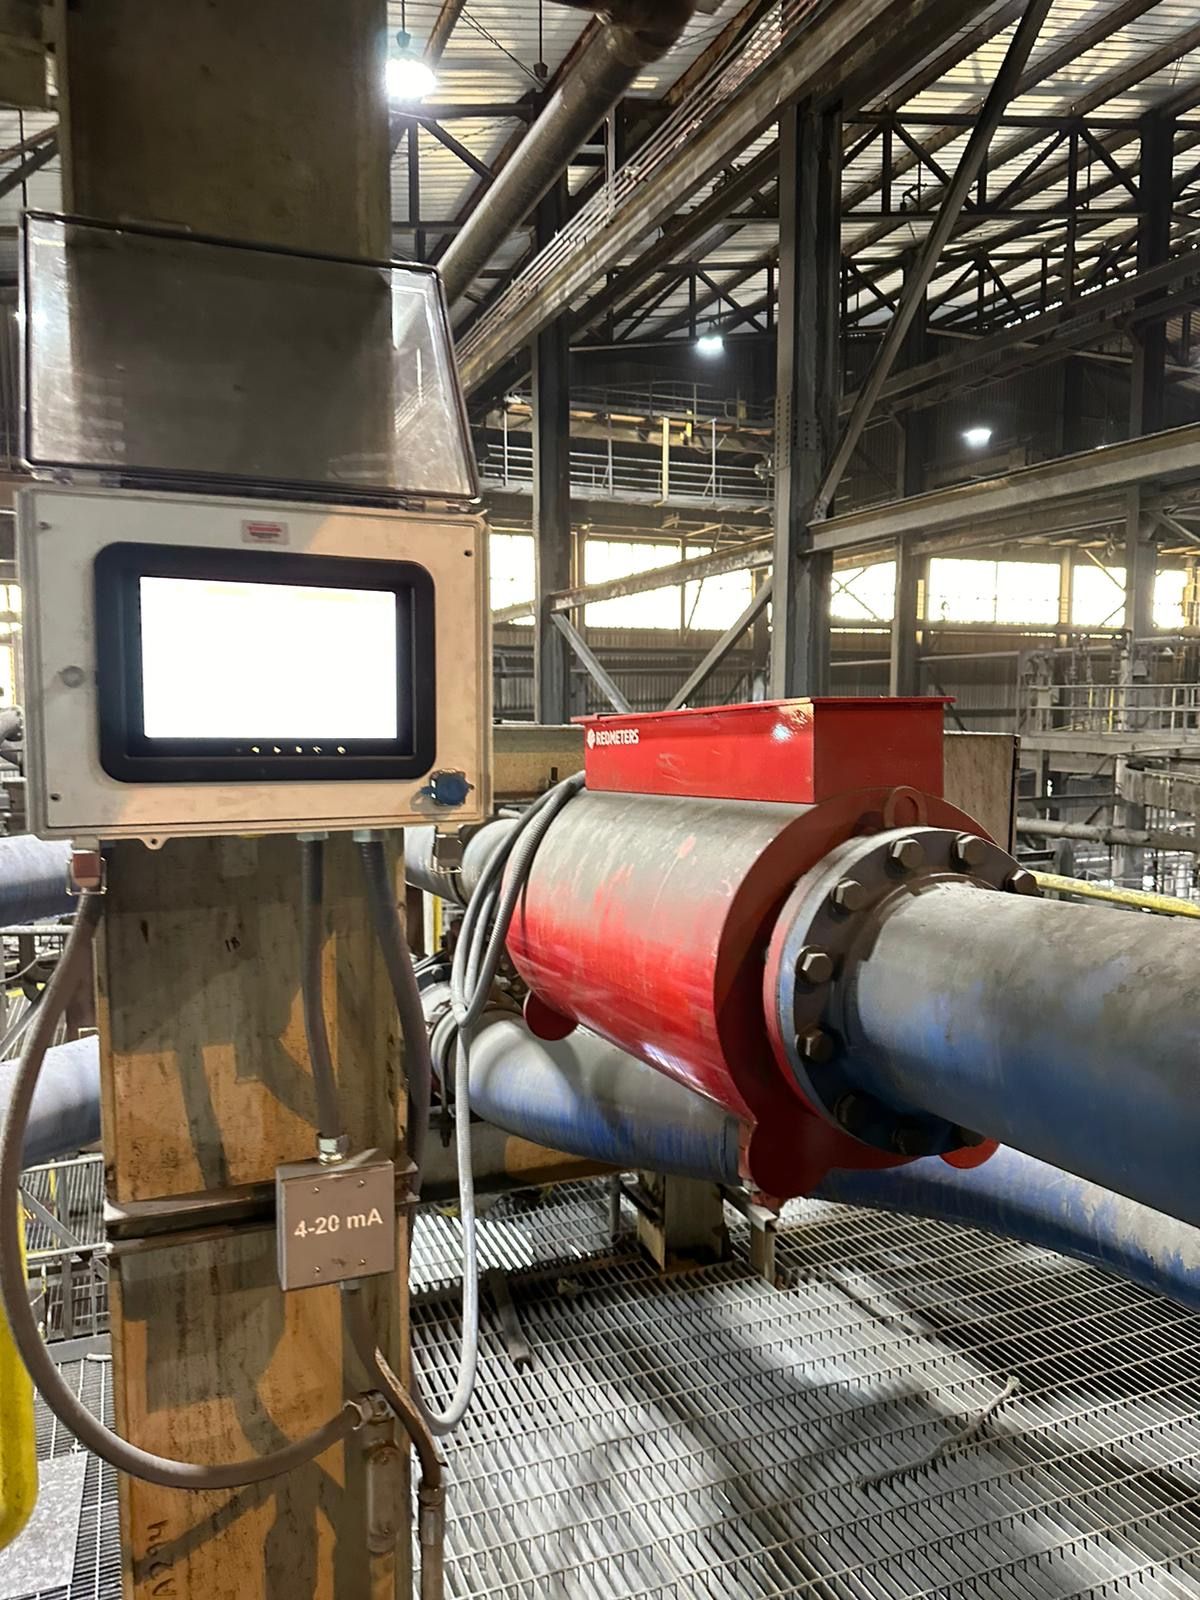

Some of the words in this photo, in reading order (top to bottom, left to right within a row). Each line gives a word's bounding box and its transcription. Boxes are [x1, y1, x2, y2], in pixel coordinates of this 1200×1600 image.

[595, 728, 640, 746] REDMETERS
[294, 1214, 340, 1238] 4-20
[346, 1208, 383, 1229] mA
